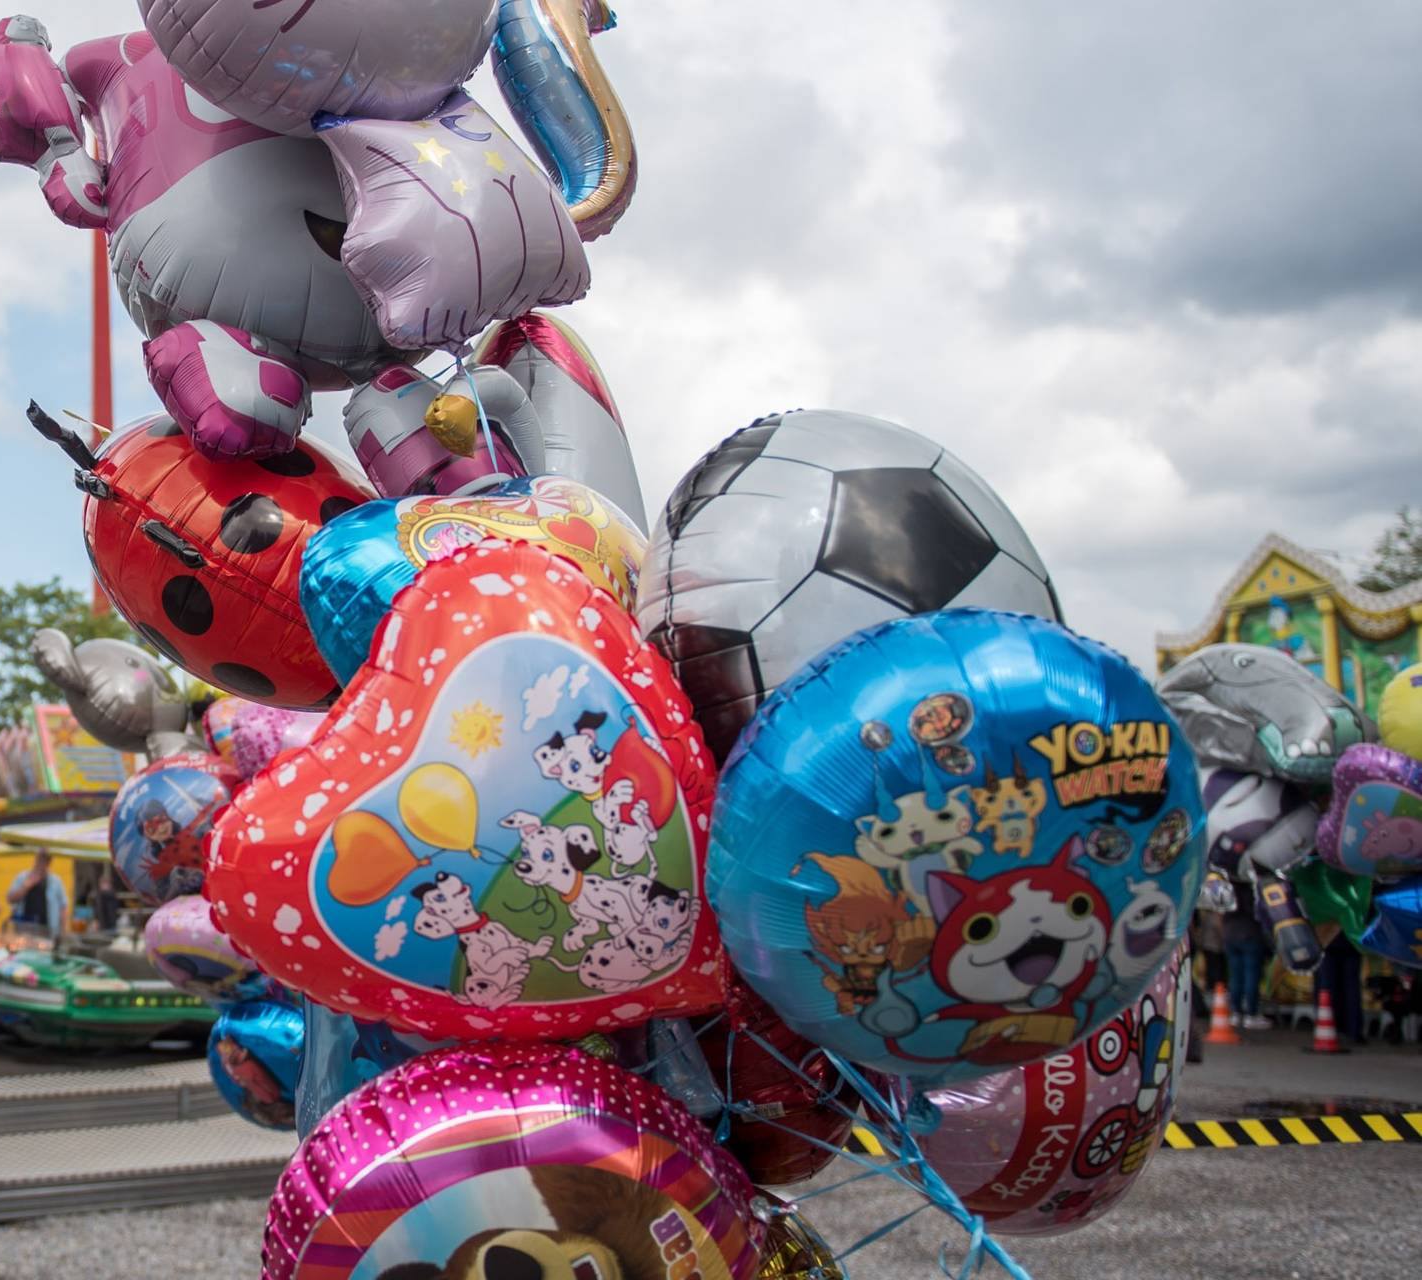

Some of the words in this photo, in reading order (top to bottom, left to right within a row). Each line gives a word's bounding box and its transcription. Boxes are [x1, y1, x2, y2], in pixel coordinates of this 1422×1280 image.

[1054, 756, 1168, 807] WATCH
[1043, 1053, 1077, 1116] llo
[990, 1123, 1076, 1200] Kitty
